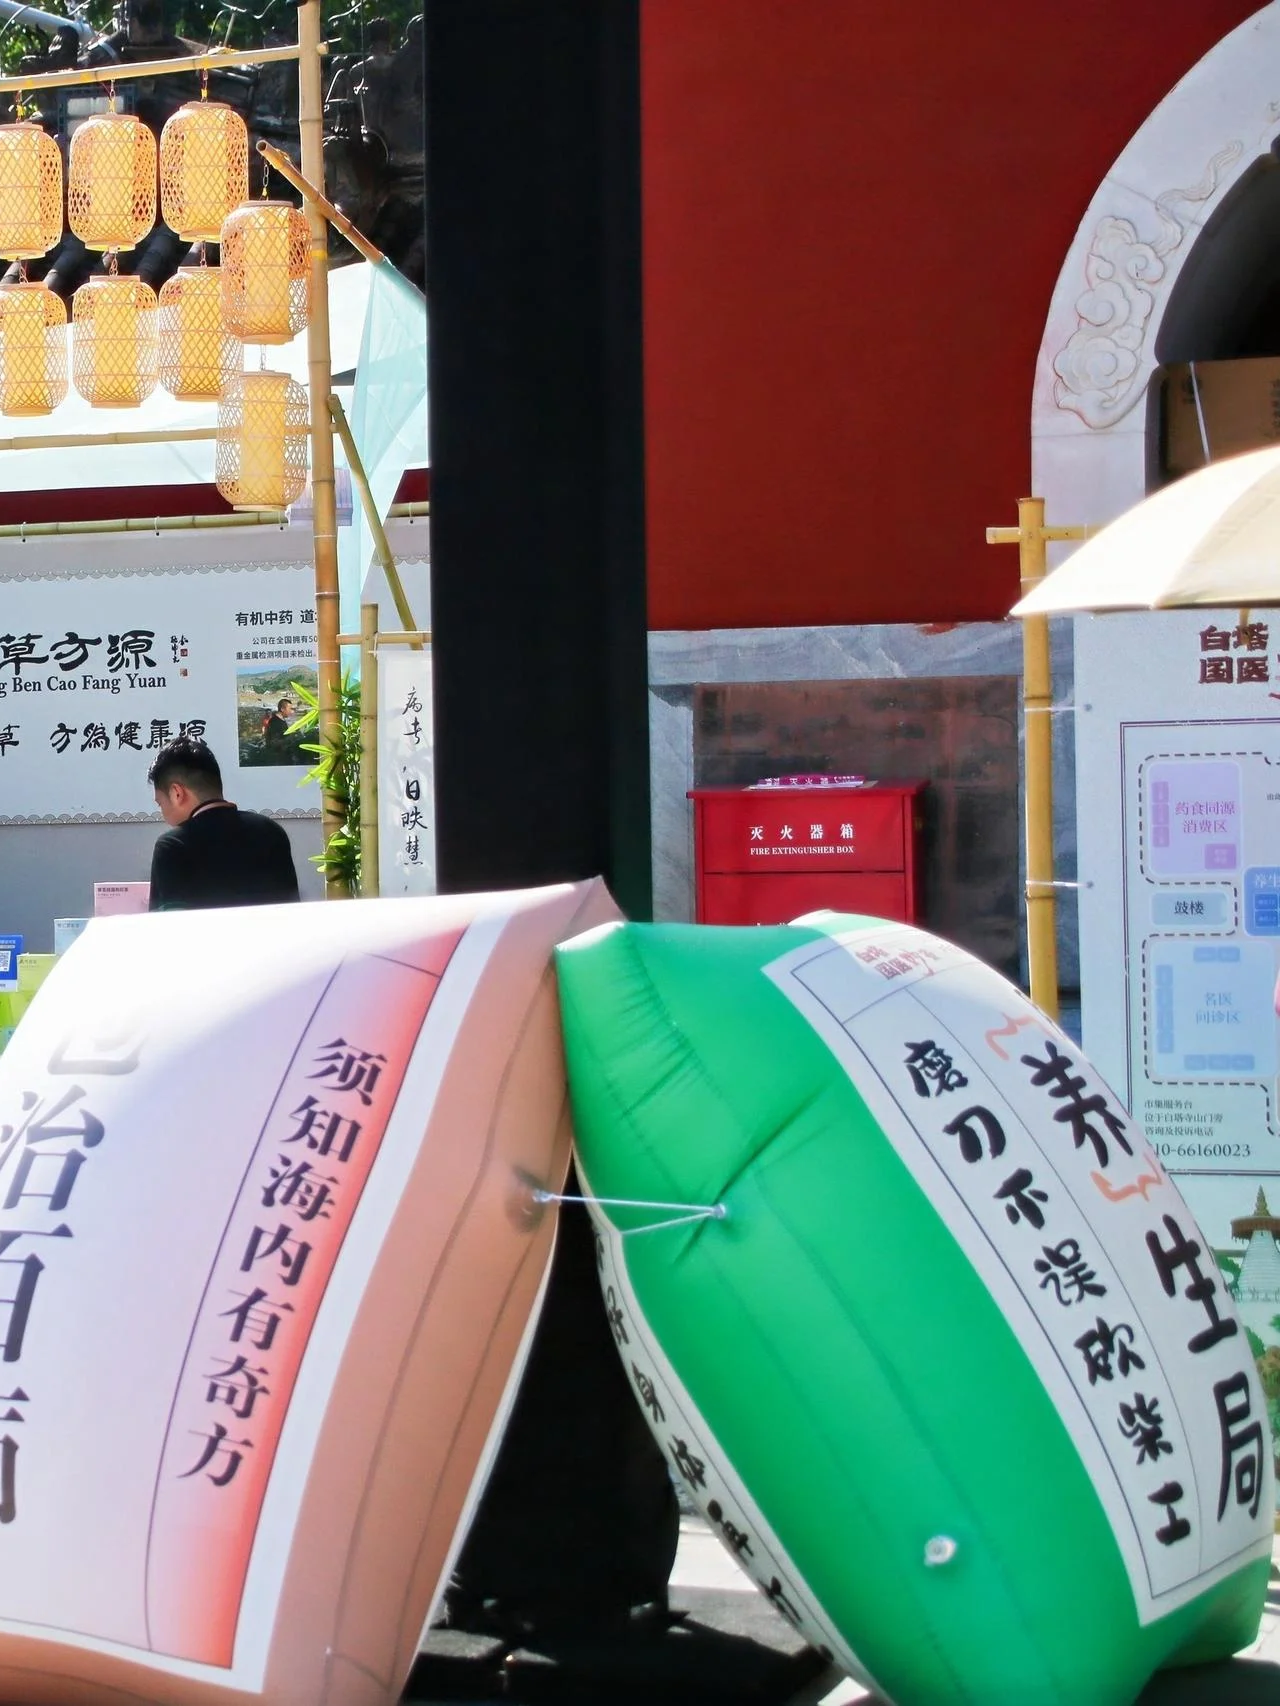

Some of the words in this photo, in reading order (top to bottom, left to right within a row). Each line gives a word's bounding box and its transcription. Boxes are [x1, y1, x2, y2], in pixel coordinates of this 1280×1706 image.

[235, 610, 293, 626] 有机中药
[300, 609, 317, 625] 道
[1199, 622, 1269, 652] 白塔
[12, 676, 42, 693] Ben
[46, 675, 77, 692] Cao
[82, 674, 122, 694] Fang
[125, 672, 167, 689] Yuan
[1175, 801, 1236, 816] 药食同源
[749, 823, 855, 840] 灭火器箱
[1183, 820, 1228, 835] 消费区
[750, 847, 770, 856] FIRE
[772, 846, 835, 855] EXTINGUISHER
[836, 845, 854, 854] BOX
[1173, 900, 1205, 916] 鼓楼
[1203, 992, 1233, 1007] 名医
[1195, 1009, 1242, 1025] 问诊区
[1144, 1125, 1215, 1137] 咨询及投诉电话
[1154, 1143, 1251, 1158] 10-66160023
[177, 1036, 388, 1488] 须知海内有奇方
[1021, 1039, 1263, 1524] 养生局
[903, 1039, 1192, 1546] 磨刀不误砍柴工
